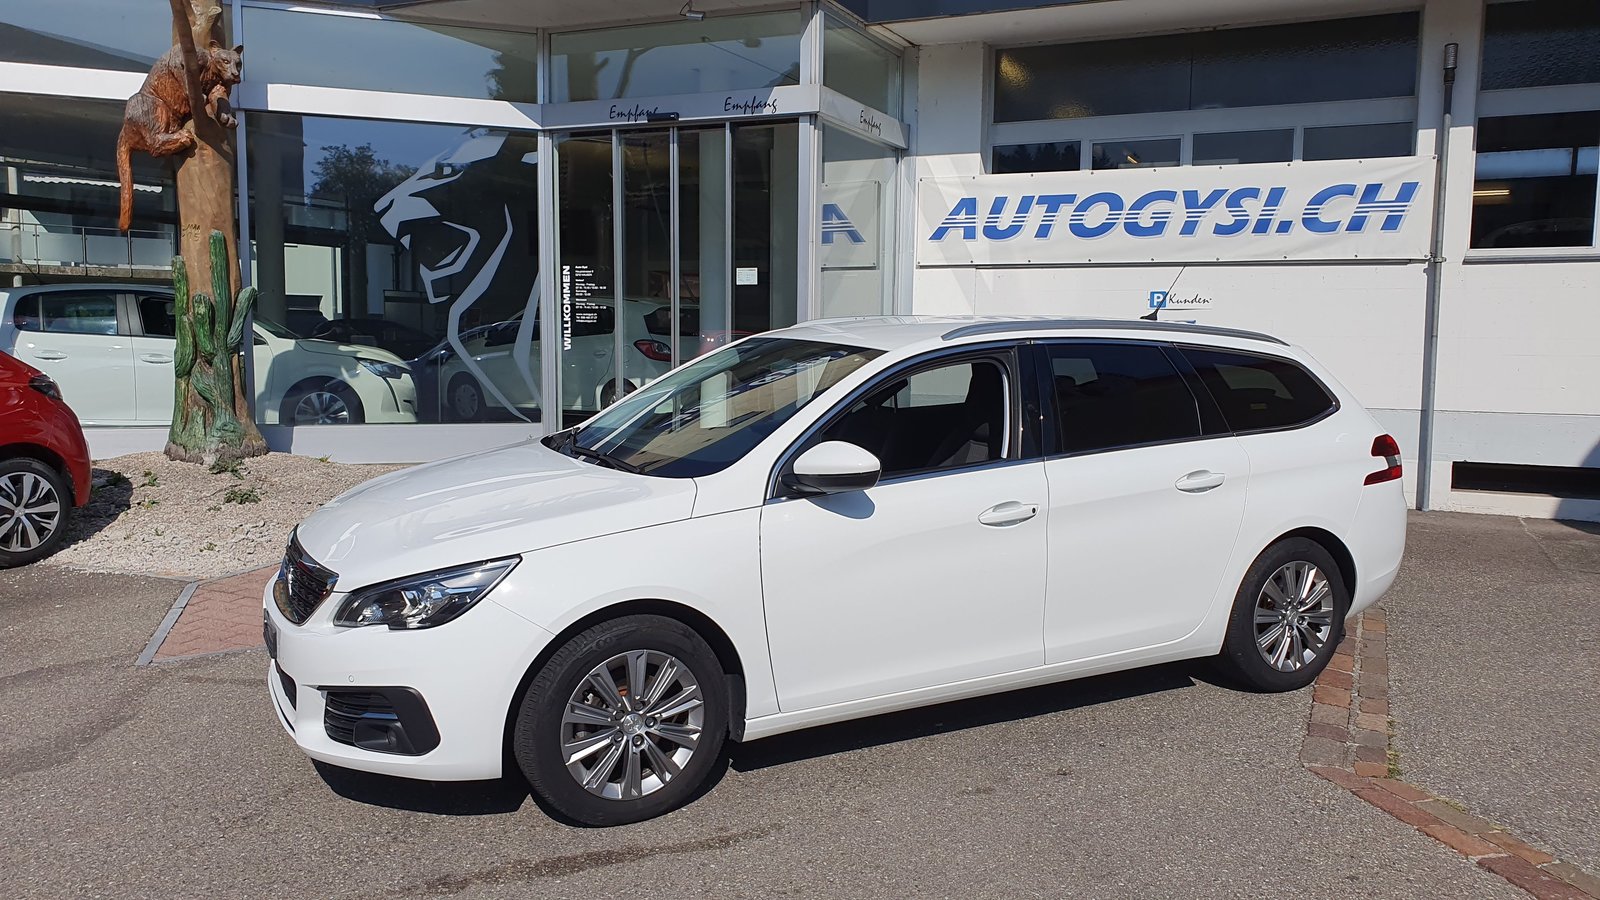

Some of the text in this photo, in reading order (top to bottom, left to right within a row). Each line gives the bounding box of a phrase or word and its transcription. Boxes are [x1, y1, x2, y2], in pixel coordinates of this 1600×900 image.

[724, 96, 777, 114] Empfang
[860, 110, 881, 136] Empfang
[928, 181, 1420, 242] AUTOGYSI.CH
[562, 265, 572, 351] WILLKOMMEN
[1153, 293, 1210, 306] P Kunden
